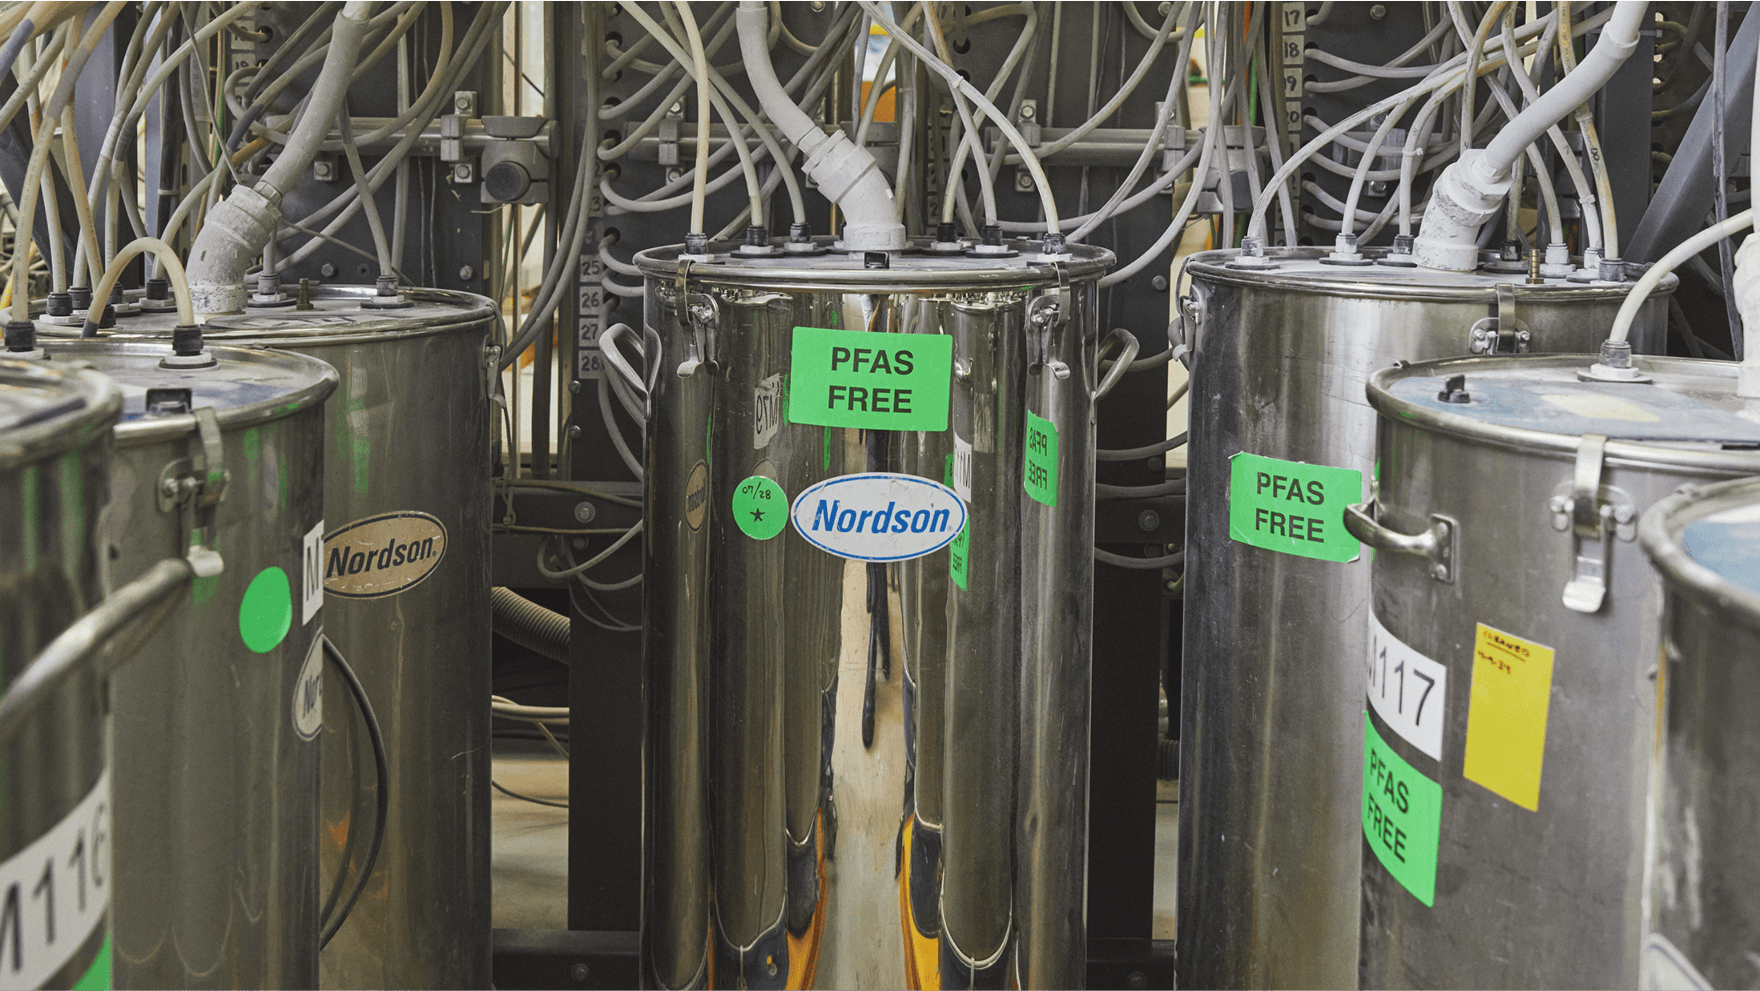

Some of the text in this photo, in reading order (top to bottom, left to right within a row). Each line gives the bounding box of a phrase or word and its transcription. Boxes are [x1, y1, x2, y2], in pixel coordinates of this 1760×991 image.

[1284, 9, 1300, 27] 17
[1284, 41, 1300, 59] 18
[592, 196, 602, 212] 3
[582, 261, 600, 276] 25
[581, 292, 600, 308] 26
[581, 324, 599, 341] 27
[581, 356, 601, 372] 28
[831, 347, 914, 375] PFAS
[828, 385, 913, 413] FREE
[742, 482, 772, 500] 07/28
[1257, 472, 1325, 505] PFAS
[812, 499, 950, 534] Nordson
[1255, 508, 1324, 543] FREE
[326, 537, 434, 578] Nordson
[1370, 748, 1410, 814] PFAS
[1368, 793, 1407, 863] FREE
